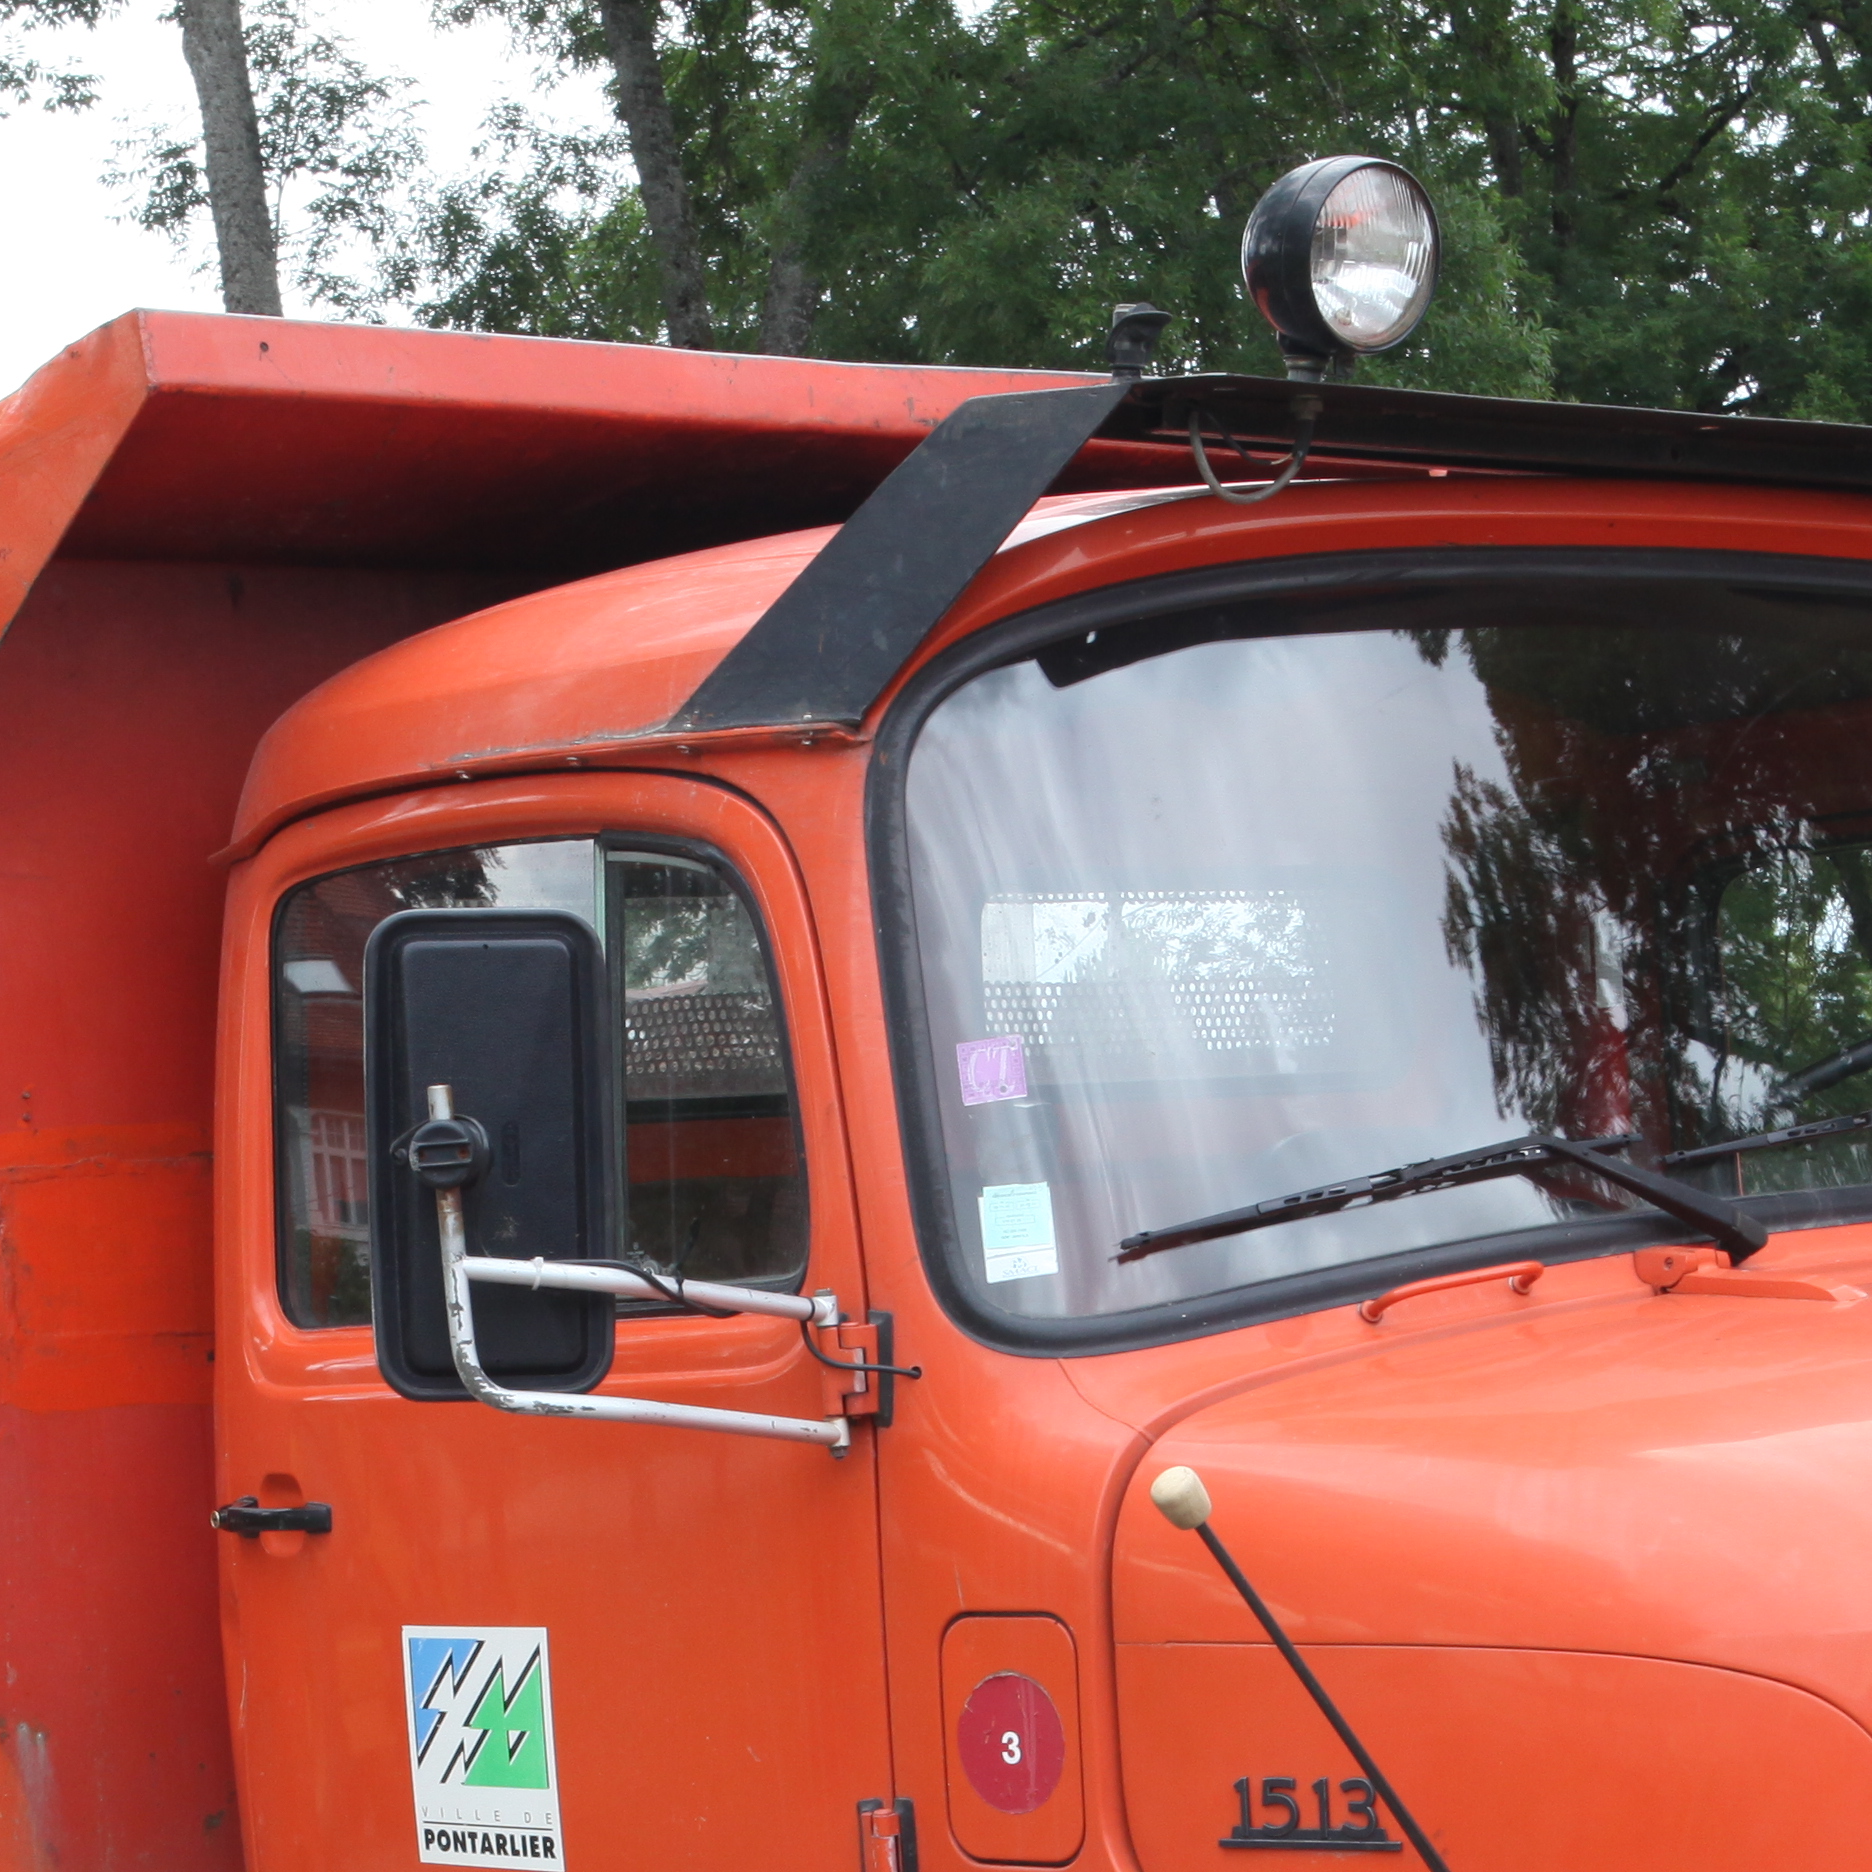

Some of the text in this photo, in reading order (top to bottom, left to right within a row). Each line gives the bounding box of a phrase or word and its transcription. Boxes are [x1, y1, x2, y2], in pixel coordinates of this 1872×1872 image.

[1001, 1731, 1022, 1765] 3
[422, 1807, 553, 1825] VILLE DE
[1232, 1777, 1379, 1839] 1513
[424, 1829, 556, 1859] PONTARLIER
